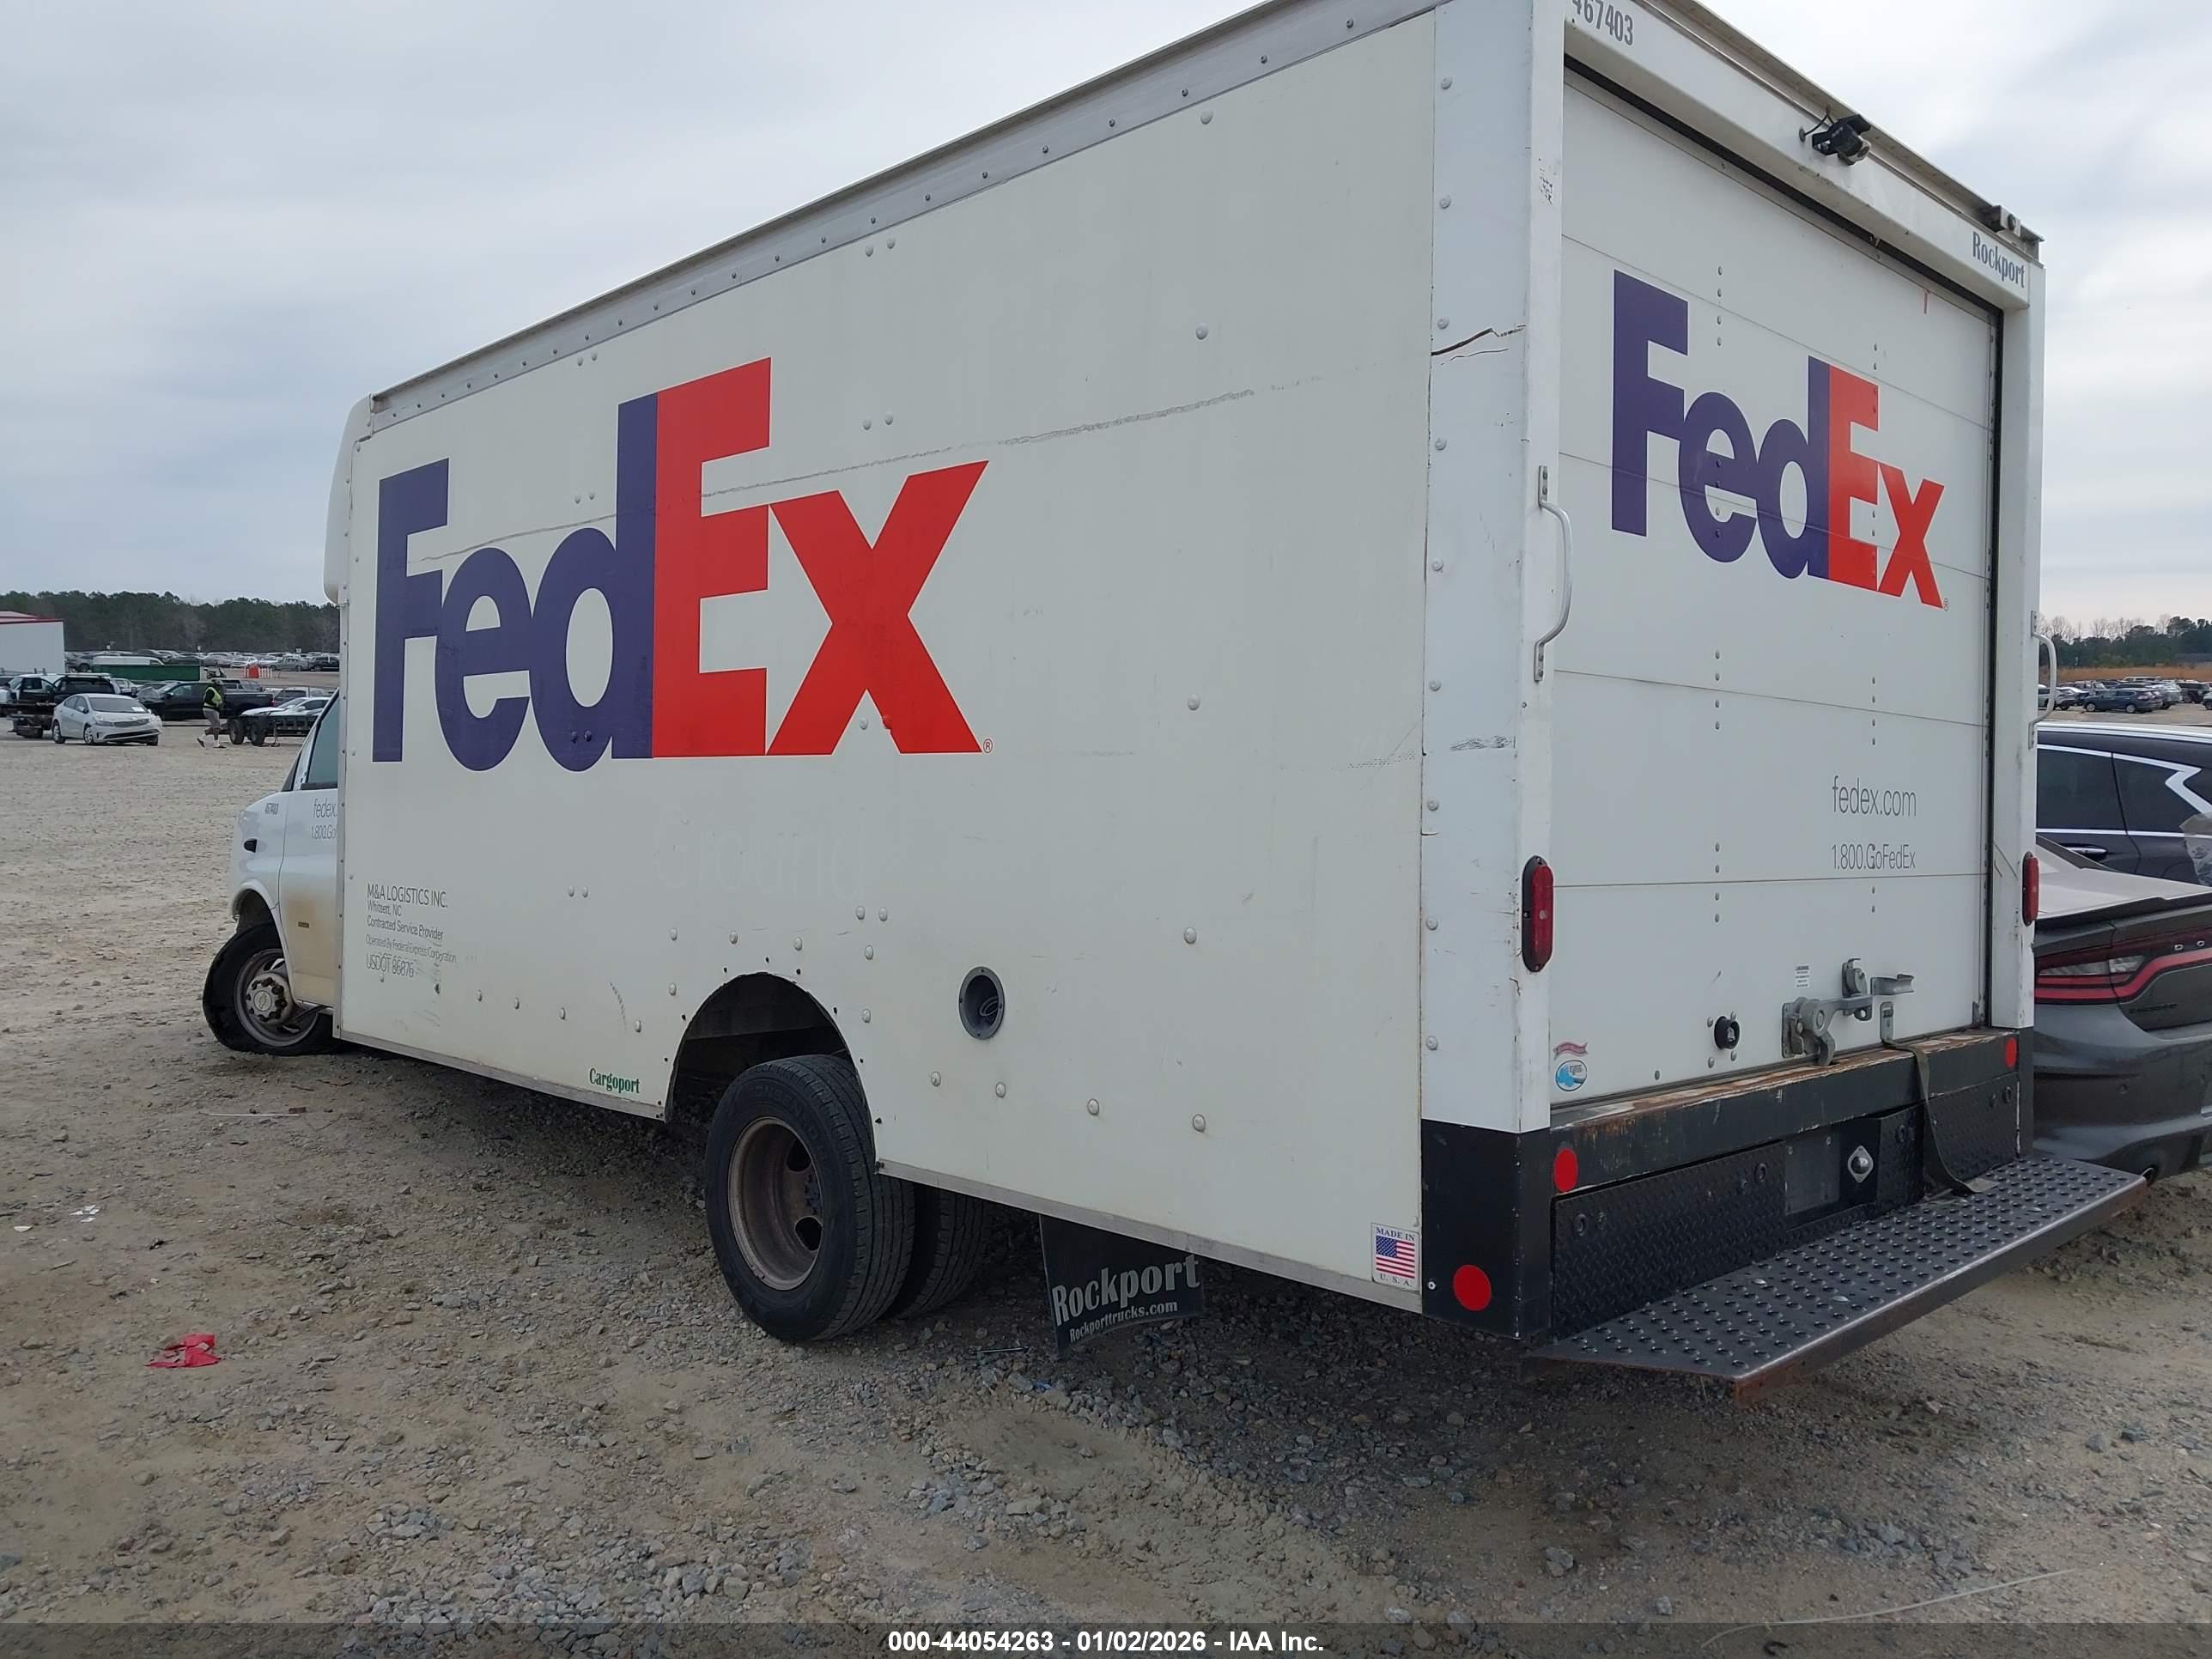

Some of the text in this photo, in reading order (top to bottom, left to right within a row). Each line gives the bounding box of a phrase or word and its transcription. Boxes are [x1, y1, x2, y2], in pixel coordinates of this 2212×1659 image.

[1972, 231, 2025, 289] Rockport
[1612, 269, 1945, 609] FedEx
[372, 357, 988, 772] FedEx
[1832, 775, 1917, 817] fedex.com
[1832, 843, 1916, 870] 1.800.GoFedEx
[367, 883, 448, 908] M&A LOGISTICS INC.
[392, 904, 402, 917] NC
[367, 915, 444, 941] Contracted Service Provider
[366, 952, 392, 973] USDOT
[589, 1067, 641, 1093] Cargoport
[1376, 1227, 1416, 1242] MADE IN
[1052, 1255, 1200, 1327] Rockport
[1069, 1301, 1179, 1343] Rockporttrucks.com
